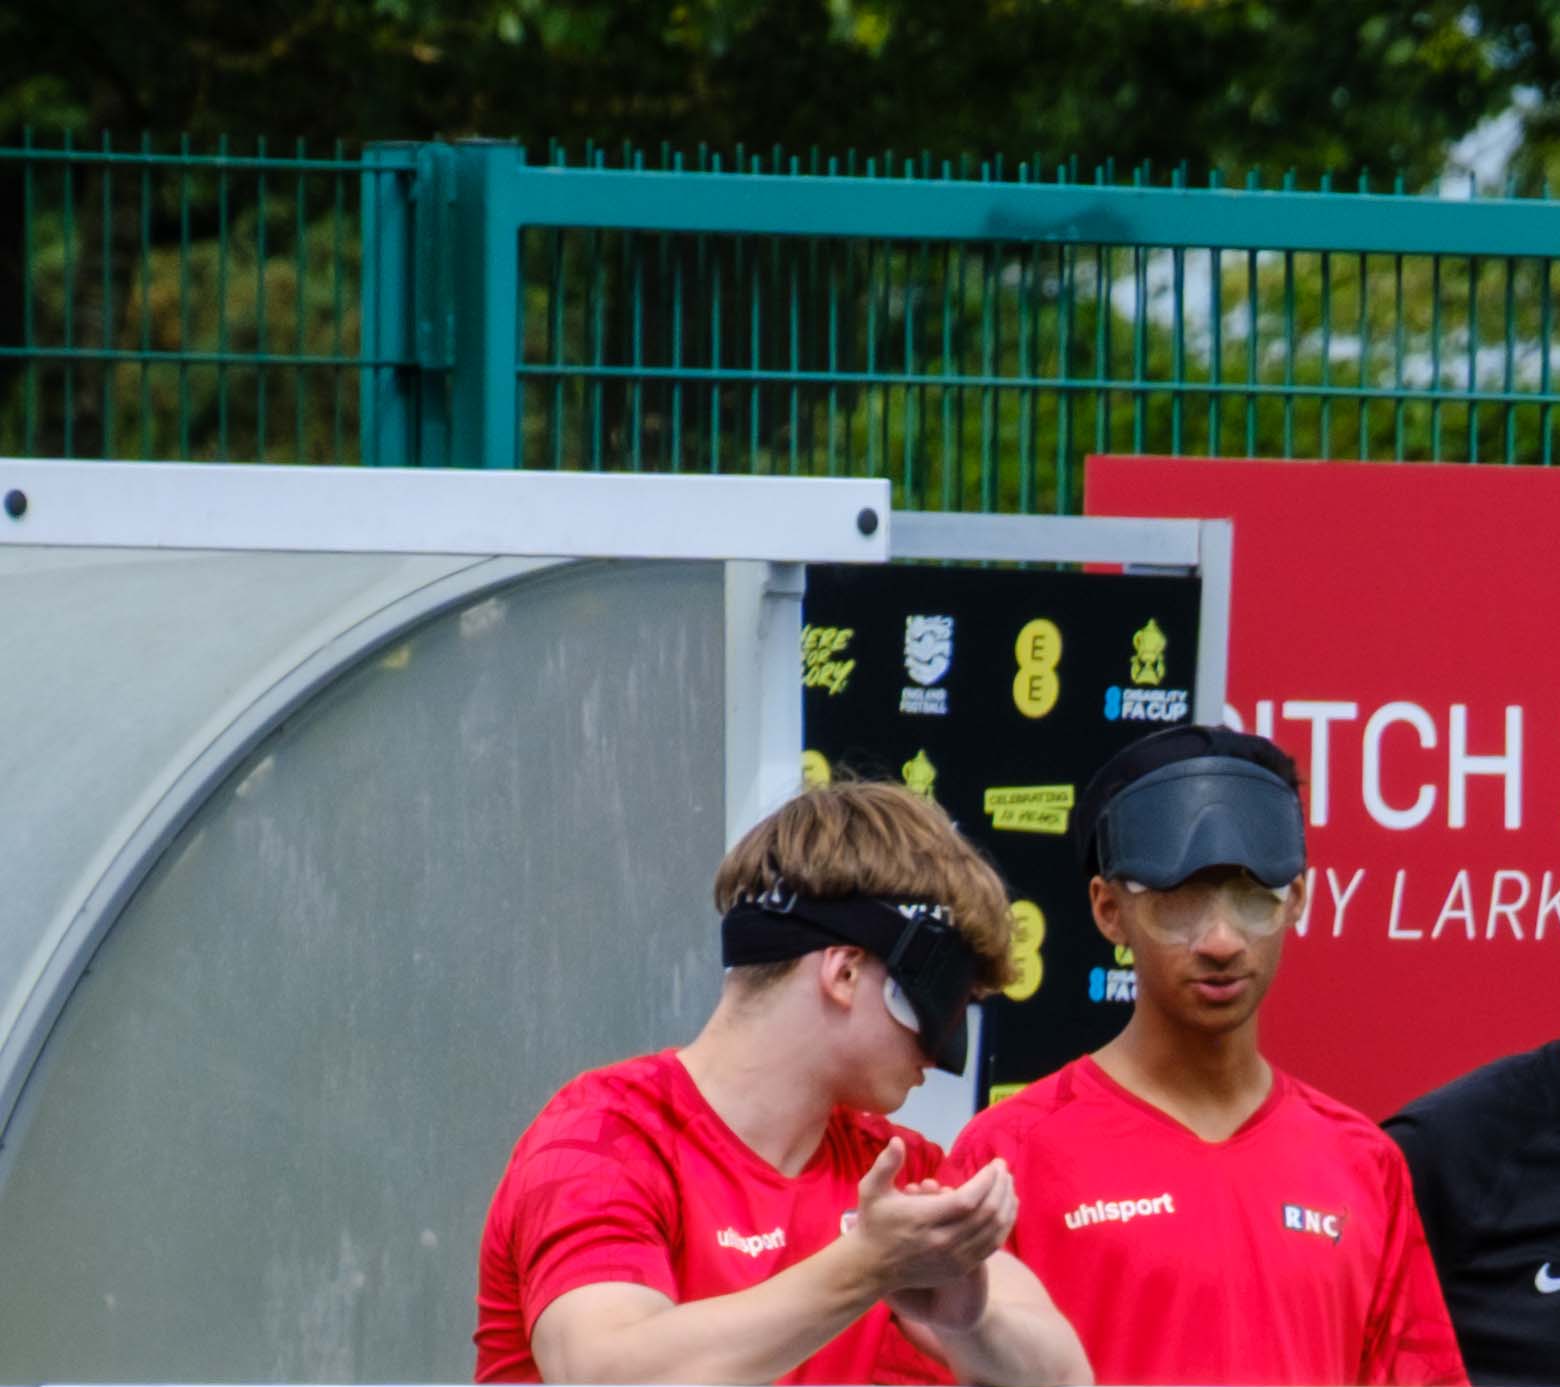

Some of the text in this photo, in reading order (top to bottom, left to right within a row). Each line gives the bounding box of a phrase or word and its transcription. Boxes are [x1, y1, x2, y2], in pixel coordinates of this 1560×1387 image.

[1122, 701, 1188, 721] FA CUP
[1224, 701, 1523, 830] TCH
[1064, 1193, 1175, 1231] uhlsport
[1285, 1205, 1339, 1238] RNC
